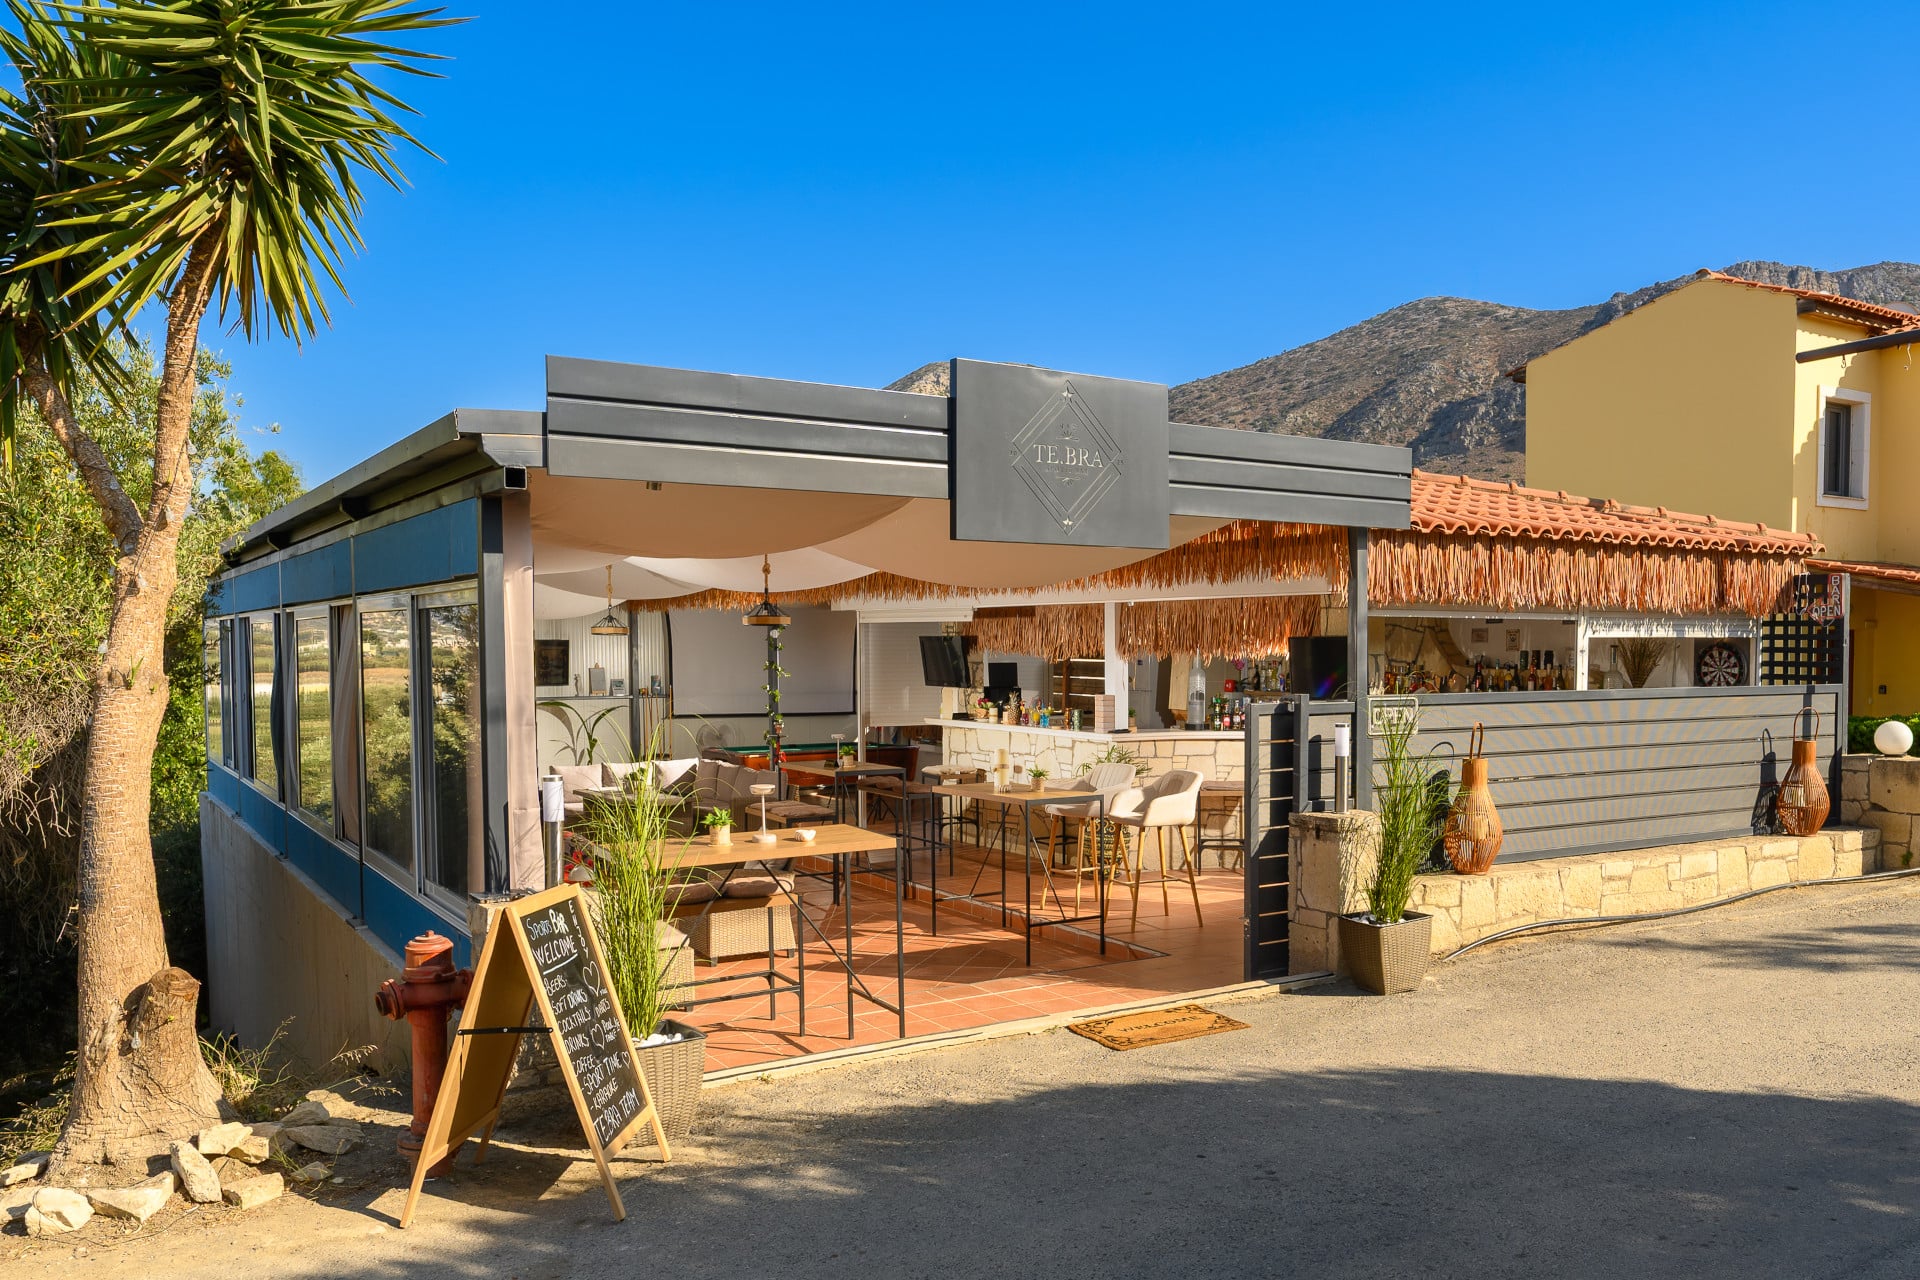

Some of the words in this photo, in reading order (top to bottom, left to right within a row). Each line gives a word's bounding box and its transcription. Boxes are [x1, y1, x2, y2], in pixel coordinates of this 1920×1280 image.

[1033, 444, 1103, 468] TE.BRA
[1831, 575, 1841, 604] BAR
[1812, 605, 1841, 617] OPEN
[1372, 706, 1414, 725] OPEN
[532, 935, 578, 967] WELCOME
[551, 994, 567, 1016] SOFT
[566, 988, 588, 1009] DRINKS
[557, 1005, 592, 1036] COCKTAILS
[602, 1051, 622, 1076] TIME
[618, 1087, 640, 1119] TEAM
